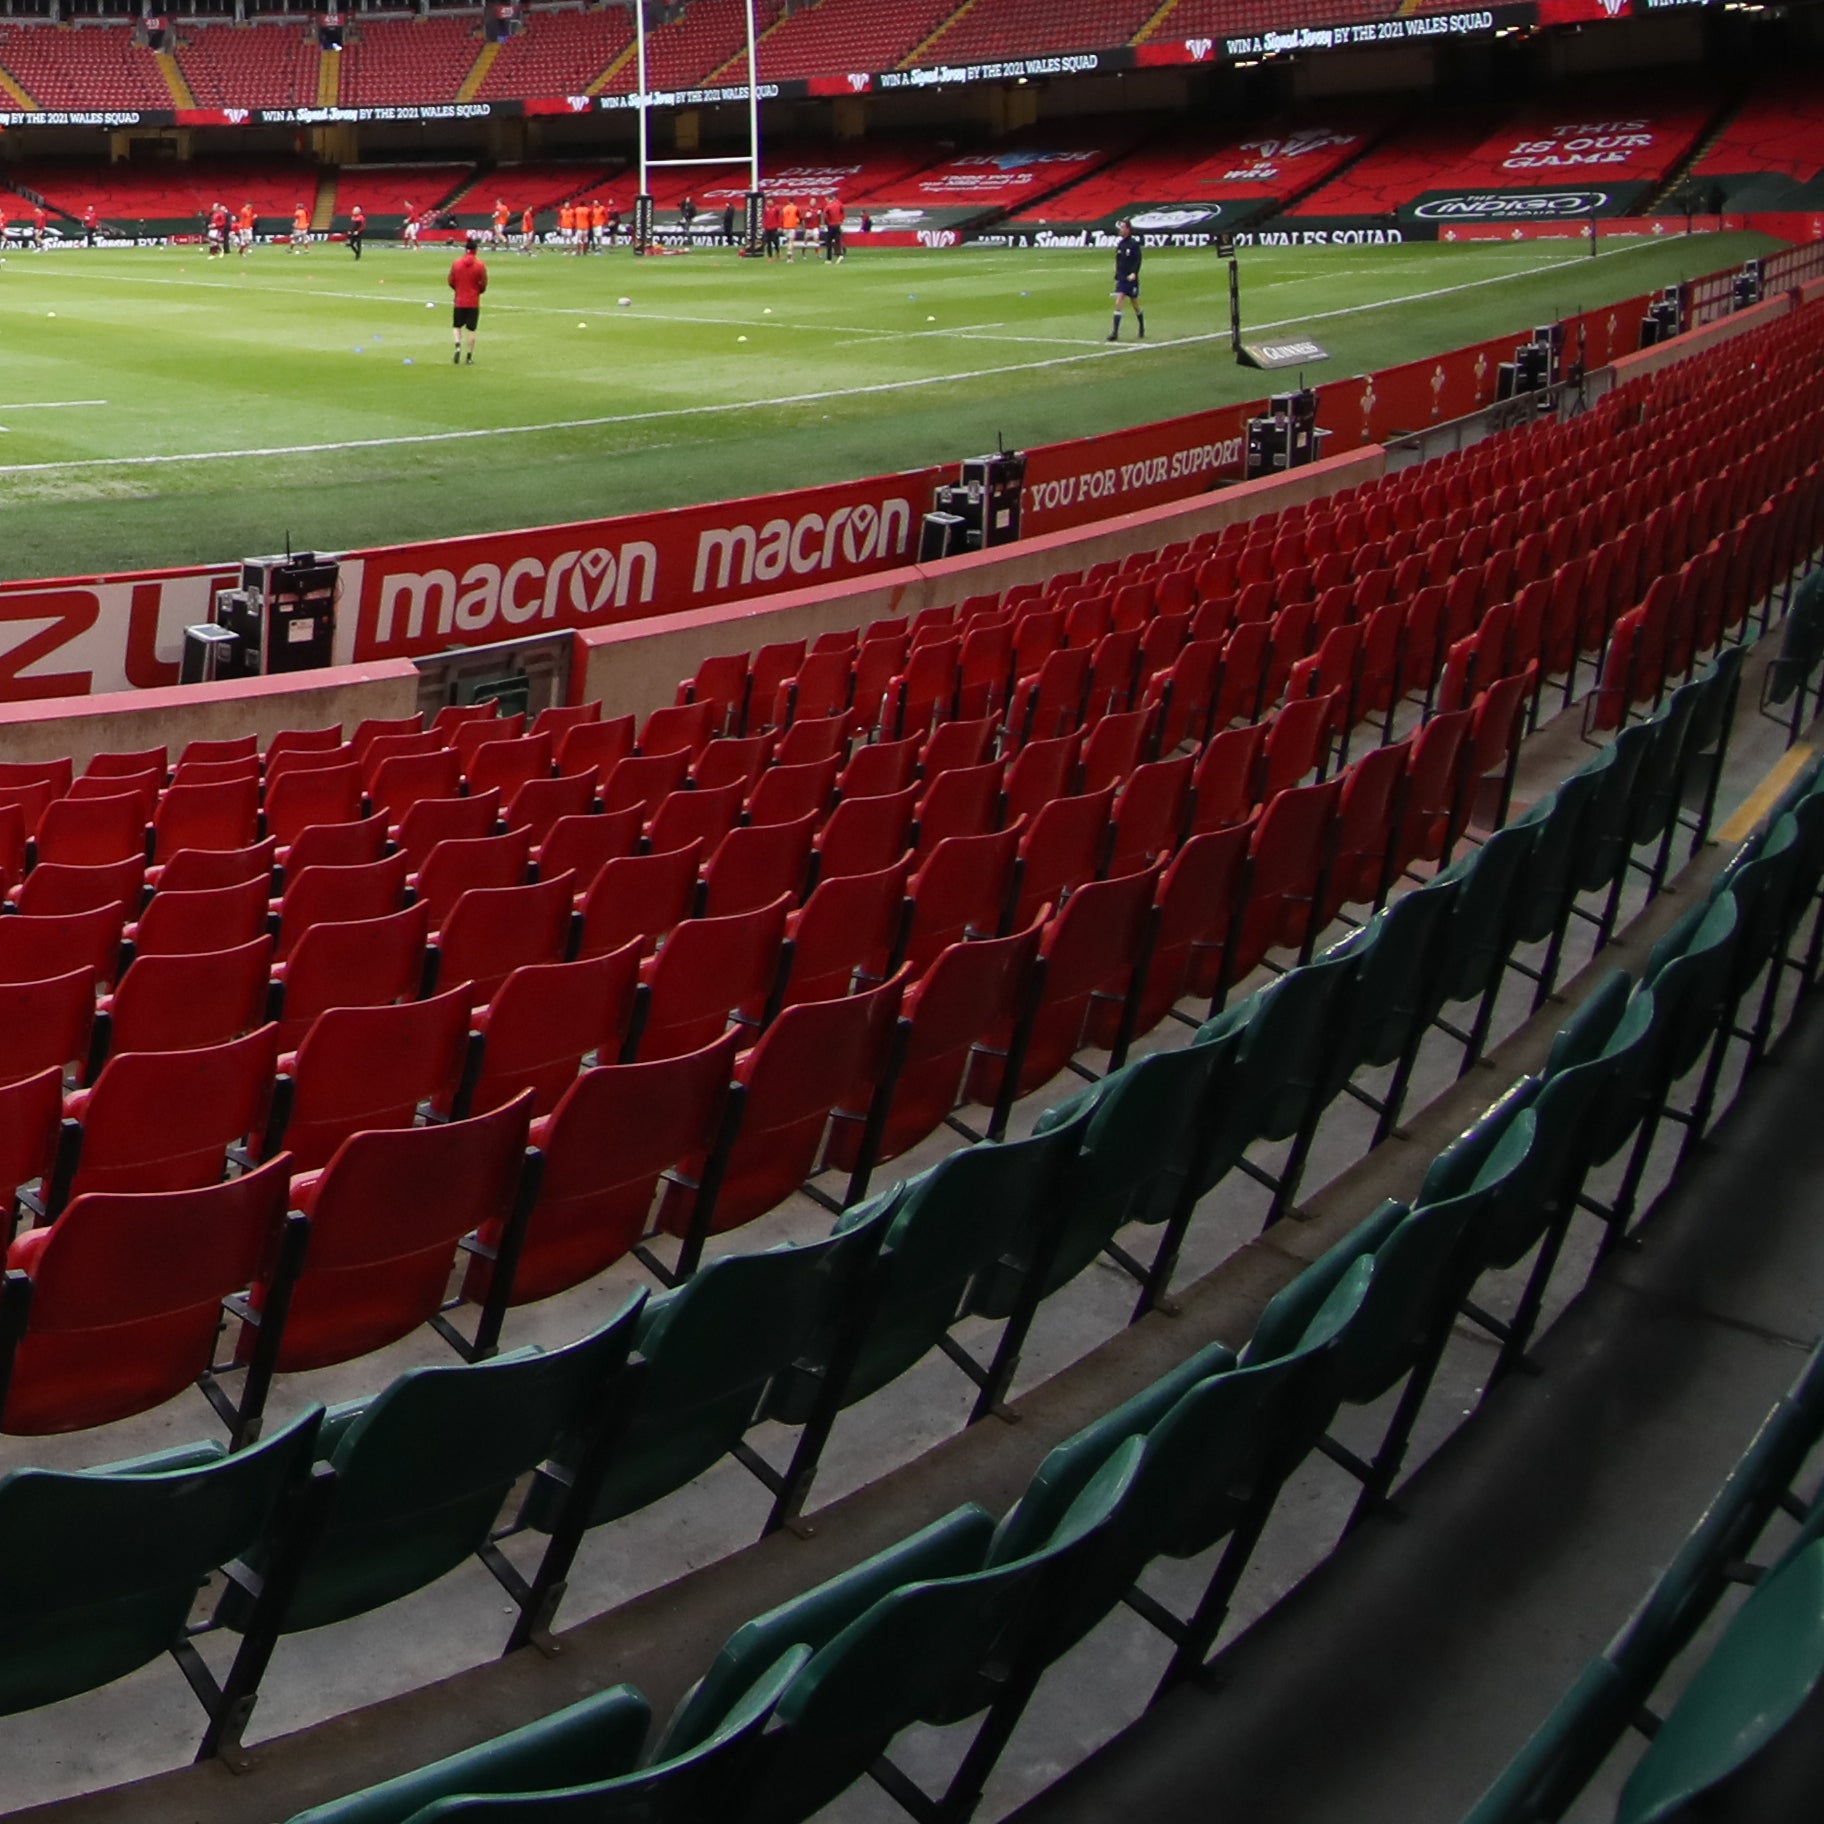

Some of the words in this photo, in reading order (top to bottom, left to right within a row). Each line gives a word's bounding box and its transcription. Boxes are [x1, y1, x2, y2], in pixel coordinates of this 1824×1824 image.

[1227, 38, 1250, 54] WIN
[1253, 38, 1262, 52] A
[1264, 29, 1298, 54] Signed
[1299, 29, 1331, 47] Jersey
[1334, 27, 1349, 43] BY
[1352, 25, 1376, 41] THE
[1378, 22, 1403, 38] 2021
[1406, 17, 1447, 36] WALES
[1450, 12, 1491, 33] SQUAD
[1553, 119, 1650, 137] THIS
[1509, 140, 1557, 155] IS
[1564, 133, 1653, 153] OUR
[1502, 150, 1633, 169] GAME
[1437, 195, 1584, 215] INDIGO
[1259, 231, 1327, 246] WALES
[1331, 229, 1401, 244] SQUAD
[1263, 342, 1319, 360] GUINNESS
[1031, 477, 1077, 513] YOU
[1077, 469, 1117, 502] FOR
[1119, 457, 1168, 491] YOUR
[1170, 437, 1243, 478] SUPPORT
[692, 497, 910, 594] macron
[375, 540, 657, 643] macron
